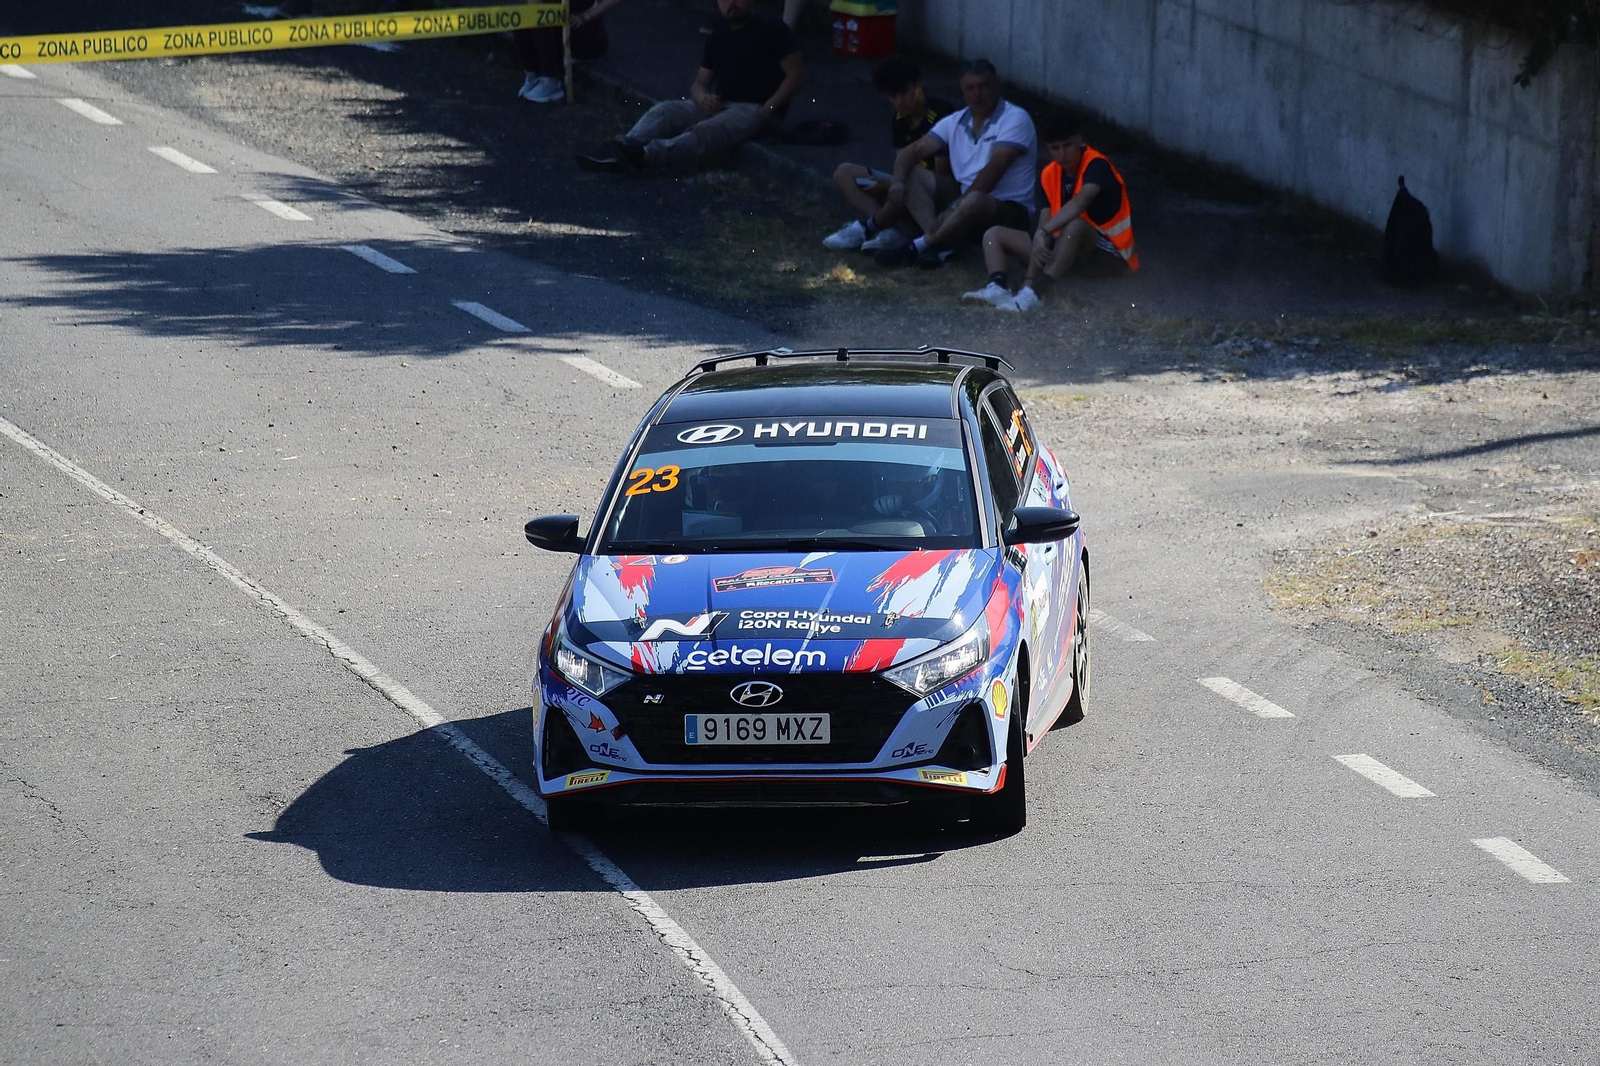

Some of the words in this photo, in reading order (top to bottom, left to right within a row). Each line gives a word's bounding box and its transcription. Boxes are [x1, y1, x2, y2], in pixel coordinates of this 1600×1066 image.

[37, 40, 79, 58] ZONA
[83, 36, 148, 55] PUBLICO
[163, 32, 205, 50] ZONA
[208, 27, 273, 47] PUBLICO
[289, 25, 330, 43] ZONA
[334, 19, 397, 39] PUBLICO
[413, 16, 454, 33] ZONA
[457, 10, 521, 30] PUBLICO
[753, 422, 928, 439] HYUNDAI
[625, 465, 681, 497] 23
[740, 610, 790, 620] Copa
[793, 610, 872, 625] Hyundai
[738, 619, 781, 630] i20N
[785, 620, 842, 634] Rallye
[686, 642, 827, 671] cetelem
[703, 717, 767, 741] 9169
[776, 717, 824, 741] MXZ
[568, 772, 607, 786] PIRELLI
[921, 770, 963, 783] PIRELLI
